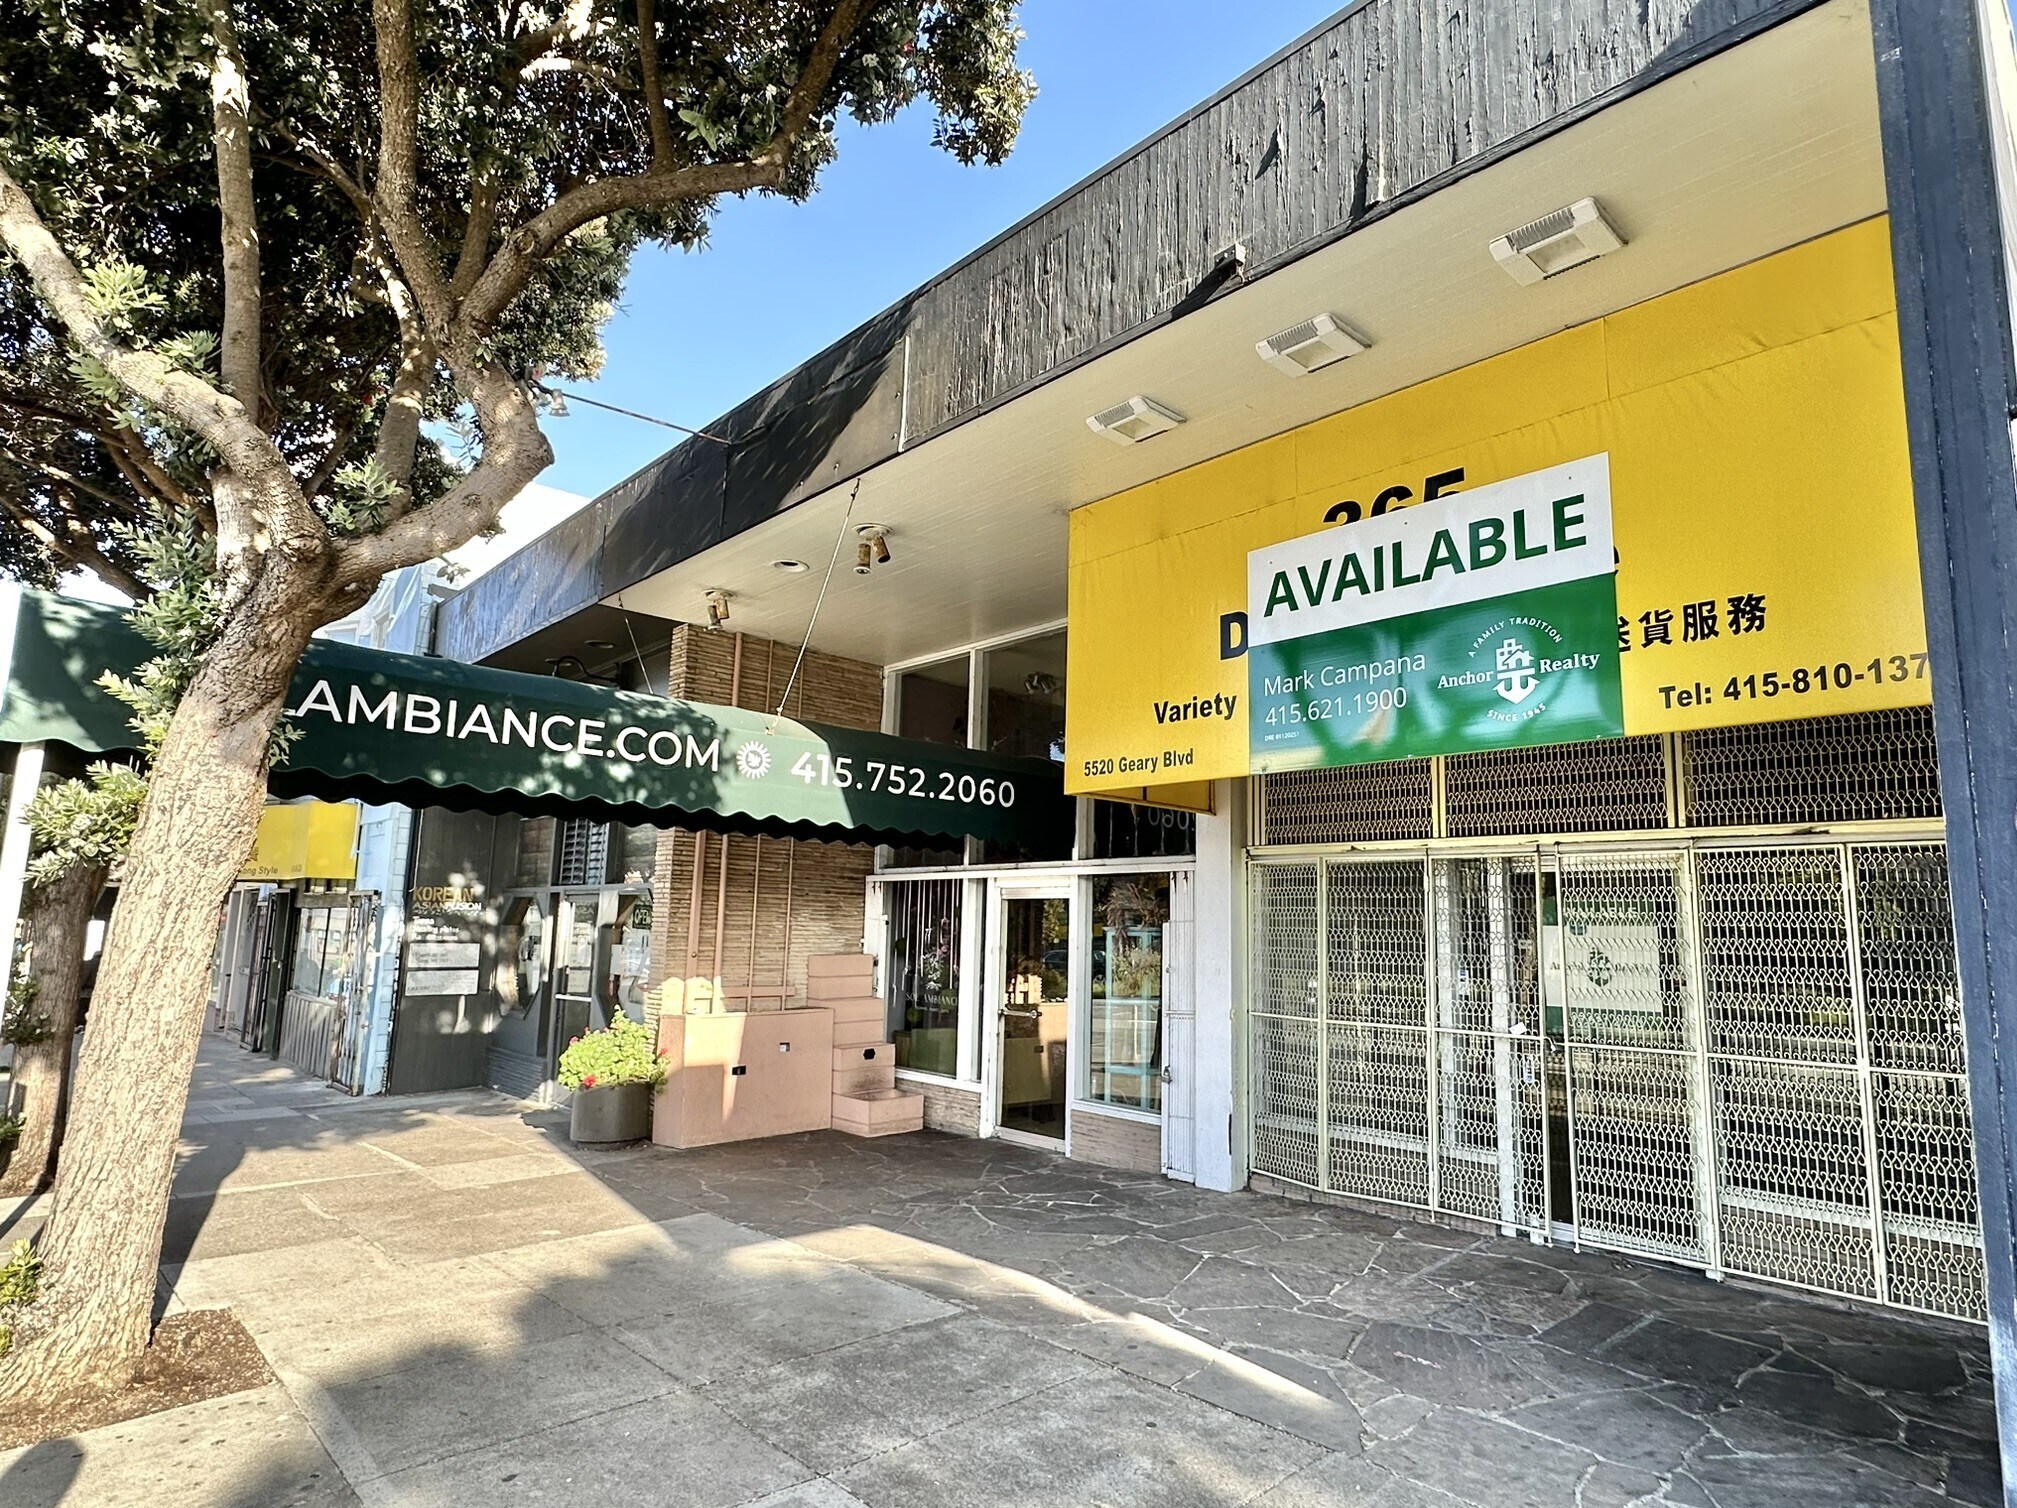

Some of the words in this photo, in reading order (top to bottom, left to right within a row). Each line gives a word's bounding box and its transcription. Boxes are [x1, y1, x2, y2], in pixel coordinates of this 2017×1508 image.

[1263, 493, 1588, 617] AVAILABLE
[1473, 620, 1505, 649] FAMILY
[1509, 617, 1563, 643] TRADITION
[1264, 670, 1315, 697] Mark
[1320, 653, 1426, 686] Campana
[1437, 670, 1494, 689] Anchor
[1539, 653, 1600, 674] Realty
[1153, 692, 1237, 724] Variety
[1265, 687, 1407, 726] 415.621.1900
[1659, 682, 1712, 709] Tel:
[282, 679, 719, 772] AMBIANCE.COM
[1487, 709, 1518, 722] SINCE
[1522, 703, 1546, 719] 1945
[1084, 758, 1113, 776] 5520
[1118, 756, 1158, 773] Geary
[1163, 748, 1194, 767] Blvd
[791, 751, 1015, 808] 415.752.2060
[240, 867, 256, 876] ong
[258, 865, 278, 876] Style
[413, 886, 475, 901] KOREAN
